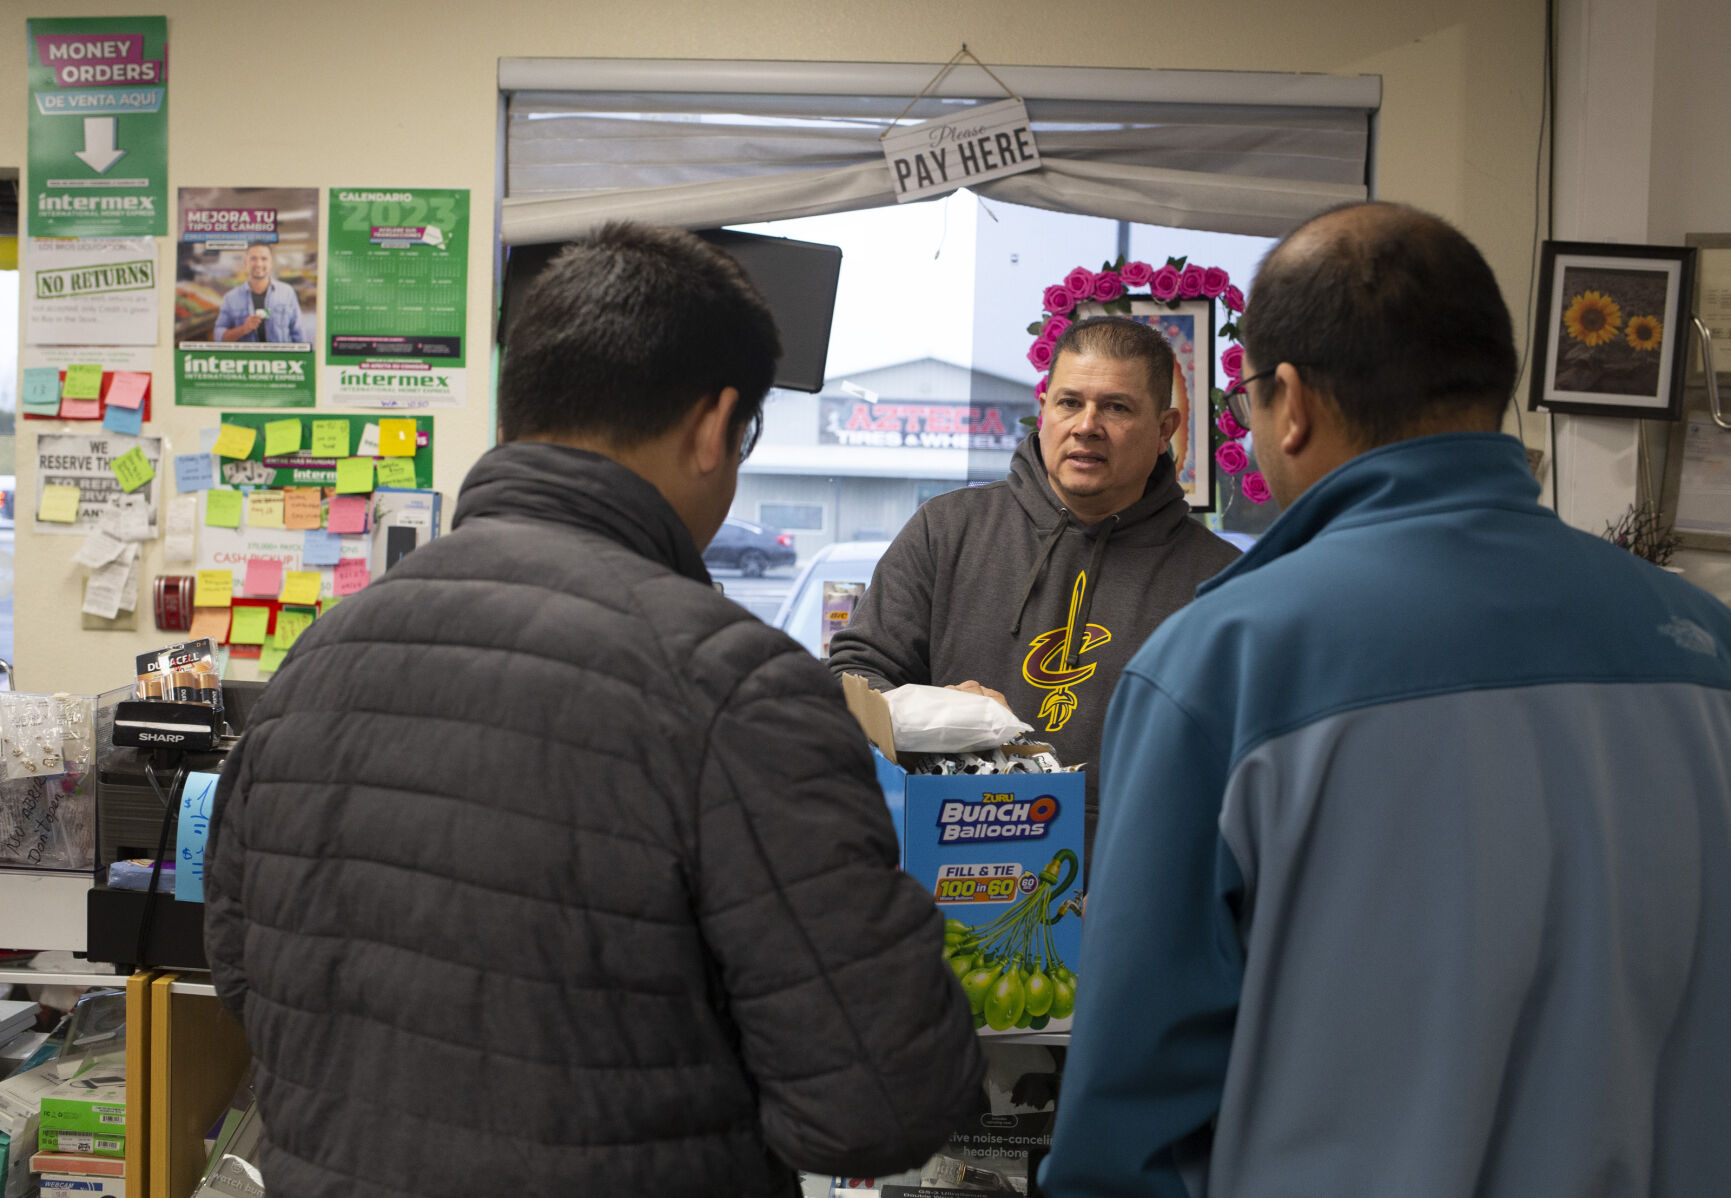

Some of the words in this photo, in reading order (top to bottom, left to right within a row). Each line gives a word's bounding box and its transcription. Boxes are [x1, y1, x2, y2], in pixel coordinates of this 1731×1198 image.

[48, 41, 131, 60] MONEY
[61, 62, 156, 83] ORDERS
[45, 96, 65, 108] DE
[68, 94, 116, 107] VENTA
[120, 91, 157, 107] AQUÍ
[928, 124, 987, 148] Please
[894, 147, 948, 192] PAY
[957, 127, 1034, 176] HERE
[38, 192, 154, 210] intermex
[339, 192, 412, 202] CALENDARIO
[187, 210, 251, 223] MEJORA
[254, 210, 275, 222] TU
[340, 197, 457, 232] 2023
[188, 223, 212, 232] TIPO
[214, 223, 229, 232] DE
[231, 223, 275, 232] CAMBIO
[41, 275, 64, 296] NO
[70, 263, 150, 292] RETURNS
[184, 354, 304, 374] intermex
[340, 370, 449, 387] intermex
[846, 405, 1006, 434] AZTECA
[89, 441, 109, 454] WE
[837, 430, 902, 447] TIRES
[919, 432, 1018, 449] WHEELS
[39, 455, 93, 471] RESERVE
[96, 457, 111, 471] TH
[293, 468, 338, 480] interm
[80, 479, 121, 490] REFU
[213, 552, 247, 564] CASH
[147, 653, 200, 672] DUACELL
[138, 733, 185, 742] SHARP
[982, 793, 1015, 803] ZURU
[28, 819, 51, 864] Don't
[46, 793, 64, 824] open
[943, 824, 1046, 840] Balloons
[946, 867, 975, 877] FILL
[979, 866, 989, 877] &
[993, 866, 1015, 876] TIE
[941, 880, 976, 897] 100
[976, 883, 986, 892] in
[987, 879, 1015, 896] 60
[973, 1133, 1055, 1146] noise-cancelin
[963, 1146, 1029, 1158] headphone
[44, 1181, 74, 1189] WEBCAM
